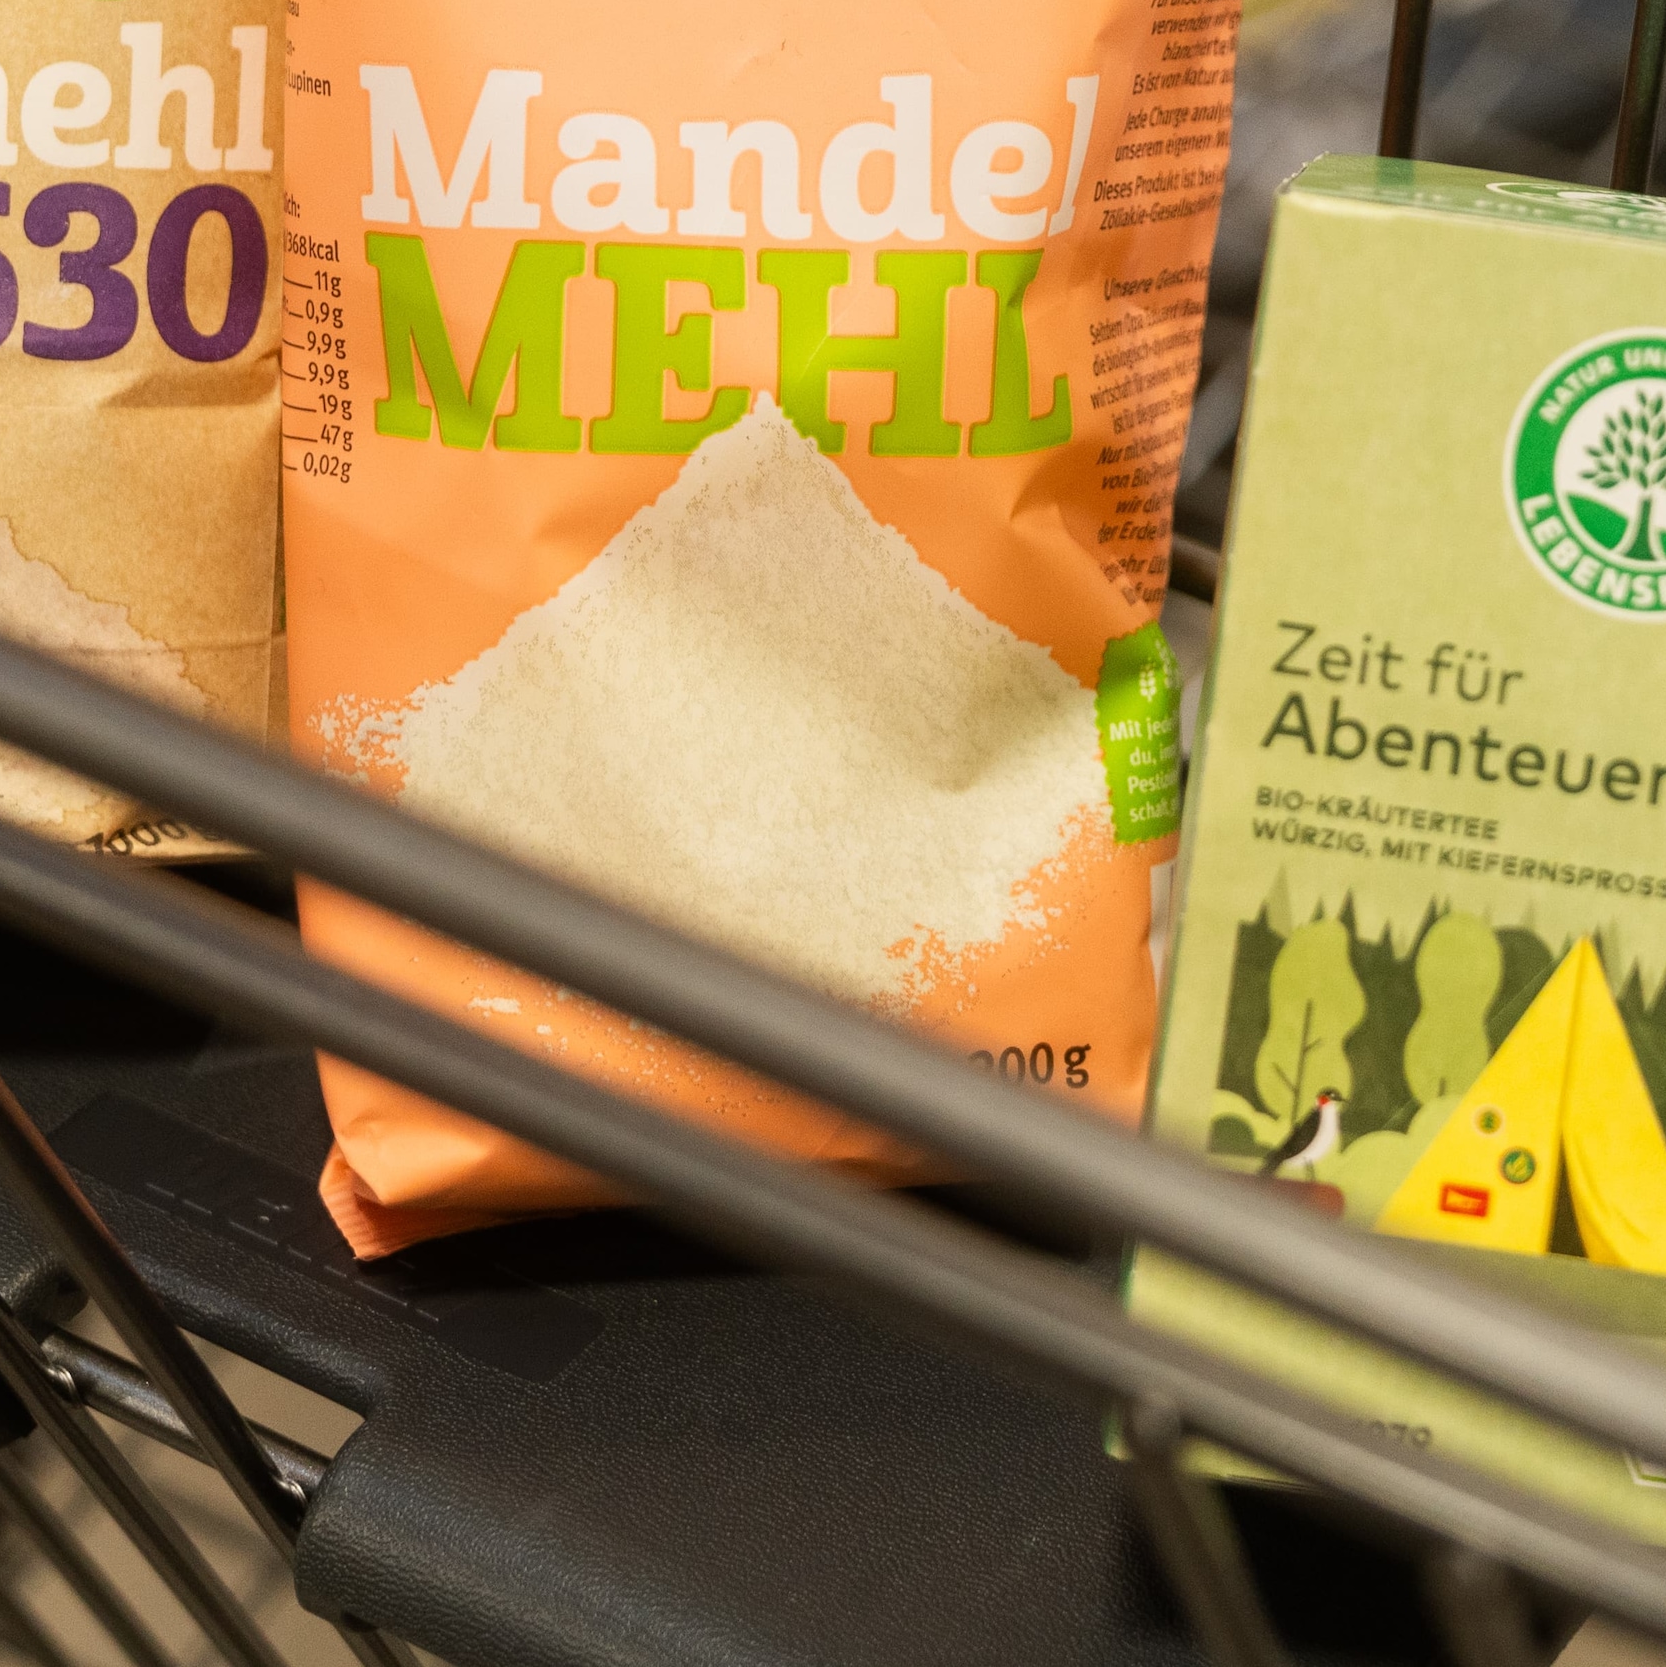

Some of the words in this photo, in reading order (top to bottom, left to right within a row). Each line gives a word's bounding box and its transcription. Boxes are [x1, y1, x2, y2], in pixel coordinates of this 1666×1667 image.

[358, 62, 1101, 243] Mandel
[1094, 180, 1133, 202] Dieses
[363, 230, 1074, 458] MEHL
[1538, 354, 1618, 425] NATUR
[1272, 619, 1404, 691] Zeit
[1425, 641, 1524, 706] für
[1251, 816, 1373, 859] WÜRZIG,
[1380, 837, 1431, 864] MIT
[1255, 785, 1500, 841] BIO-KRÄUTERTEE
